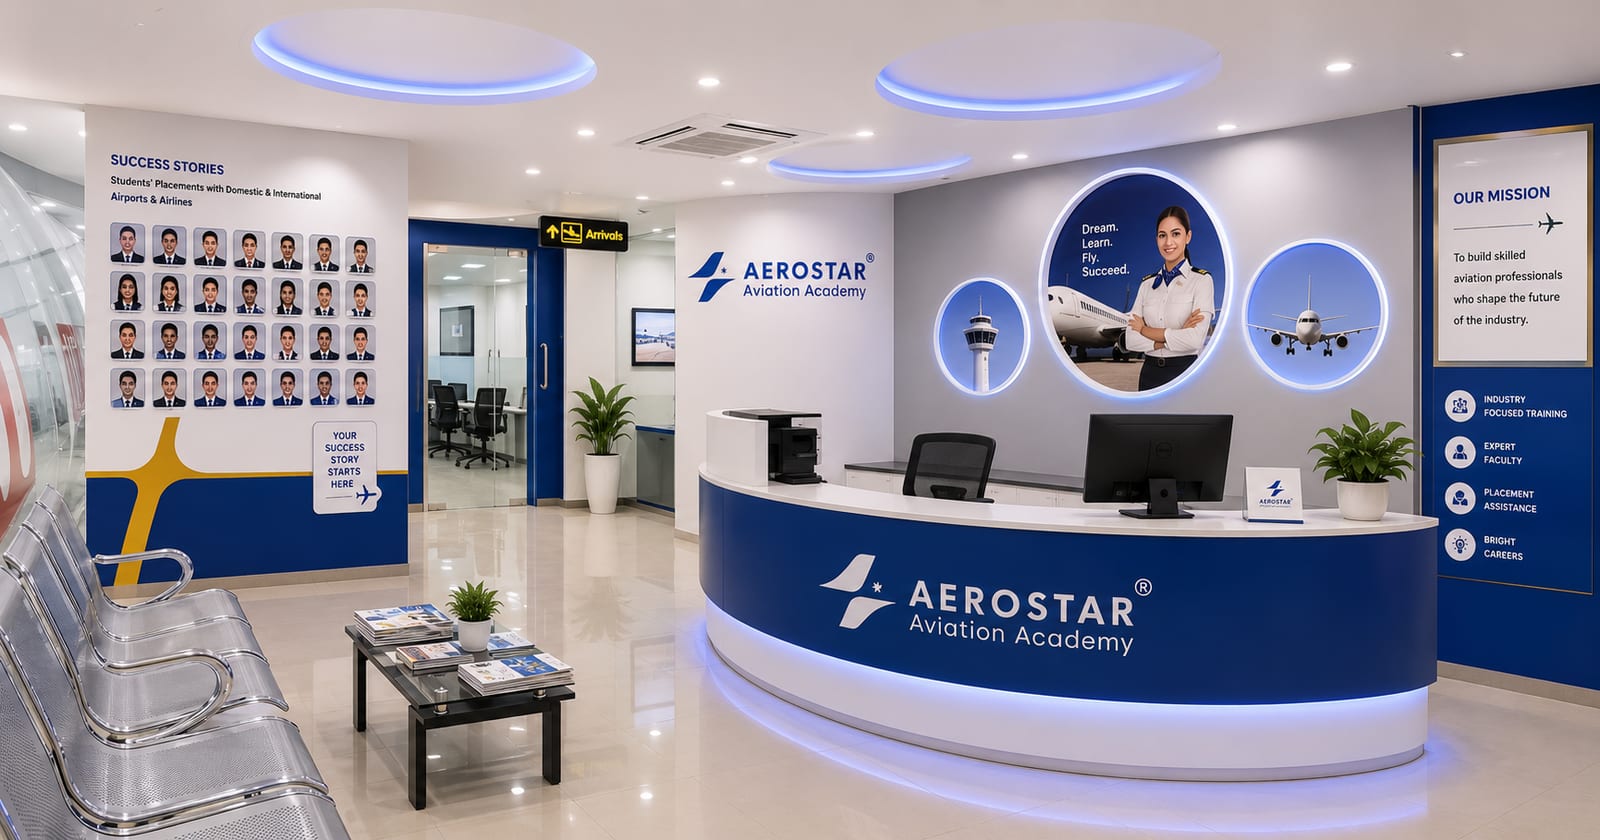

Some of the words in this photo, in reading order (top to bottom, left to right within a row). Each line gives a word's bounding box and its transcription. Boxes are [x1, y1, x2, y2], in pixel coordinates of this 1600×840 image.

[111, 153, 170, 171] SUCCESS
[174, 160, 224, 175] STORIES
[155, 179, 204, 193] Placements
[207, 184, 224, 193] with
[226, 185, 263, 196] Domestic
[266, 188, 271, 196] &
[273, 189, 321, 200] International
[111, 193, 148, 205] Airports
[150, 195, 157, 204] &
[159, 196, 192, 207] Airlines
[1453, 191, 1484, 204] OUR
[1488, 186, 1550, 202] MISSION
[1082, 223, 1118, 234] Dream.
[586, 229, 623, 241] Arrivals
[1082, 238, 1112, 248] Learn.
[1082, 253, 1099, 264] Fly.
[1454, 253, 1465, 262] To
[1468, 252, 1491, 261] build
[1494, 250, 1525, 260] skilled
[1082, 264, 1130, 277] Succeed.
[1454, 273, 1492, 283] aviation
[1495, 270, 1563, 283] professionals
[744, 285, 800, 297] Aviation
[805, 285, 866, 299] Academy
[1454, 295, 1474, 304] who
[1477, 294, 1506, 305] shape
[1510, 293, 1525, 302] the
[1529, 292, 1560, 301] future
[1454, 315, 1464, 325] of
[1467, 315, 1482, 324] the
[1485, 315, 1528, 326] industry.
[1484, 396, 1525, 404] INDUSTRY
[1484, 409, 1524, 417] FOCUSED
[1526, 410, 1567, 418] TRAINING
[333, 431, 357, 441] YOUR
[325, 443, 365, 452] SUCCESS
[1484, 442, 1515, 451] EXPERT
[331, 455, 359, 465] STORY
[1484, 456, 1522, 464] FACULTY
[328, 467, 361, 477] STARTS
[331, 479, 354, 489] HERE
[1484, 488, 1534, 498] PLACEMENT
[1484, 503, 1536, 513] ASSISTANCE
[1484, 536, 1516, 546] BRIGHT
[1484, 550, 1523, 560] CAREERS
[910, 614, 1005, 643] Aviation
[1015, 626, 1134, 656] Academy
